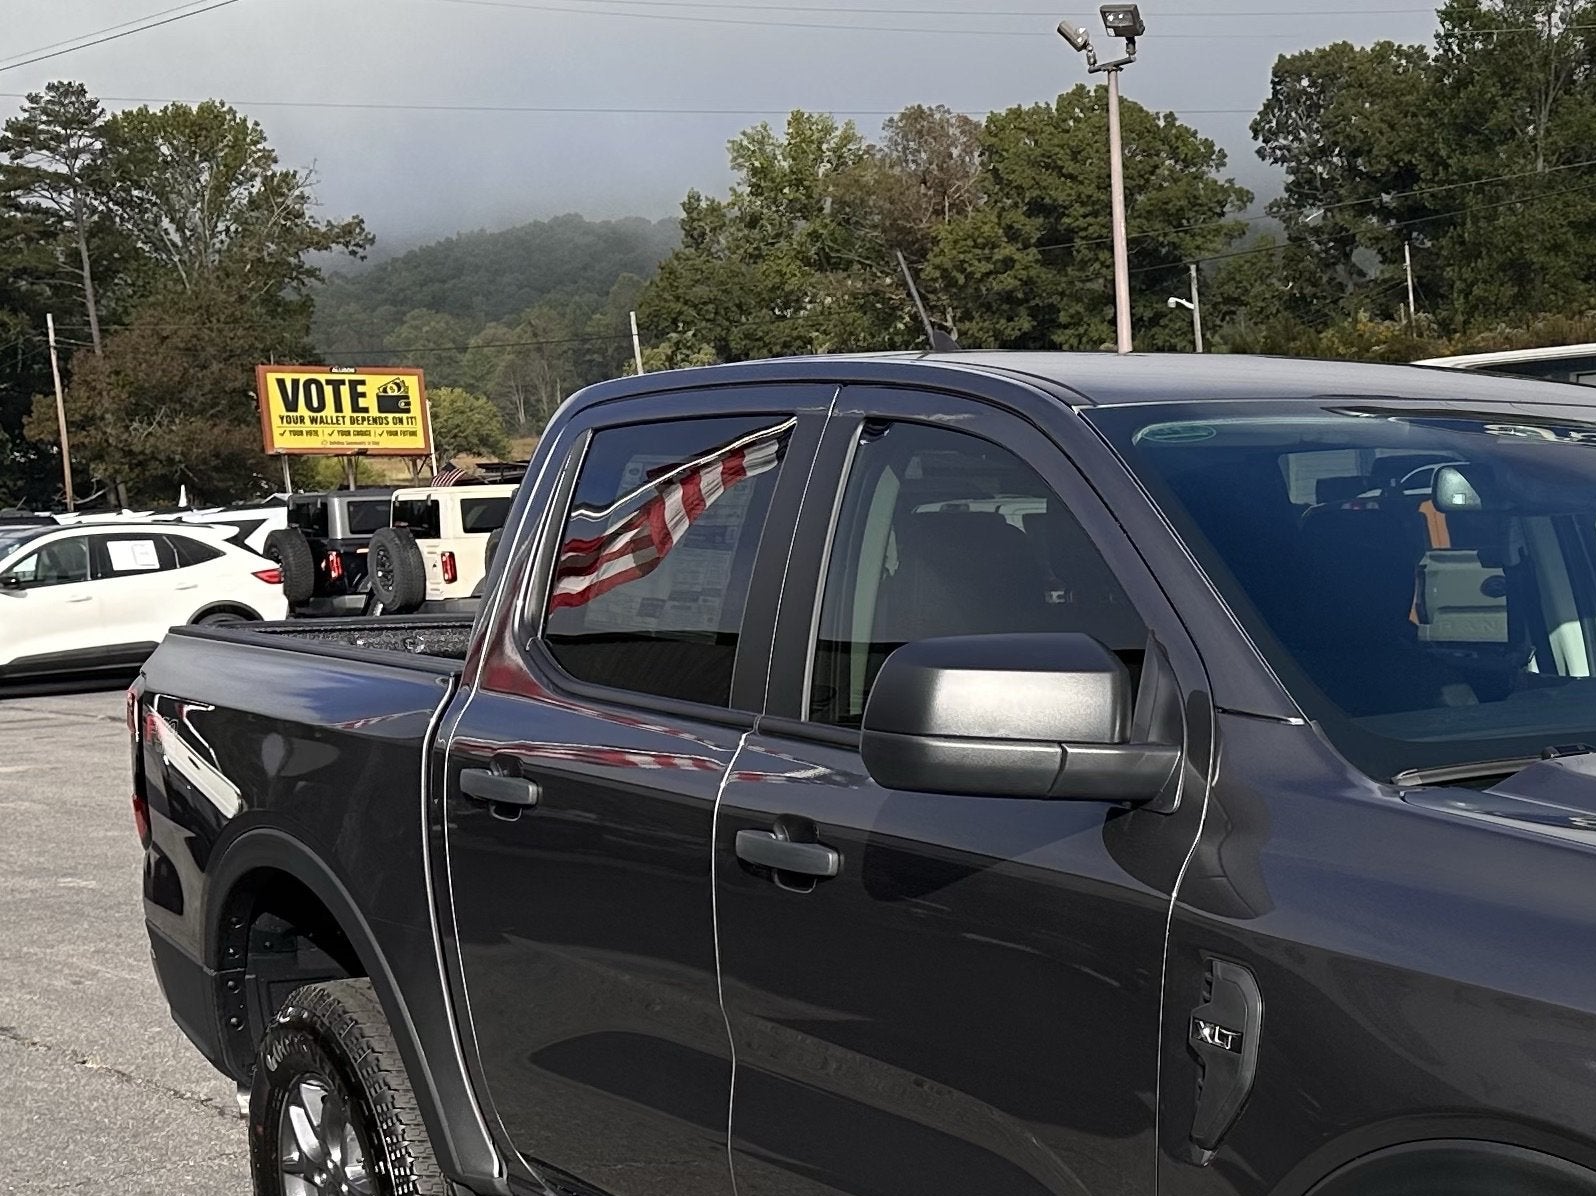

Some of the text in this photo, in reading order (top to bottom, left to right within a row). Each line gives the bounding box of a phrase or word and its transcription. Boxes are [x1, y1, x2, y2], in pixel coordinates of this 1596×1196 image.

[275, 378, 370, 414] VOTE
[279, 415, 418, 426] YOUR WALLET DEPENDS ON IT!
[1194, 1018, 1242, 1050] XLT
